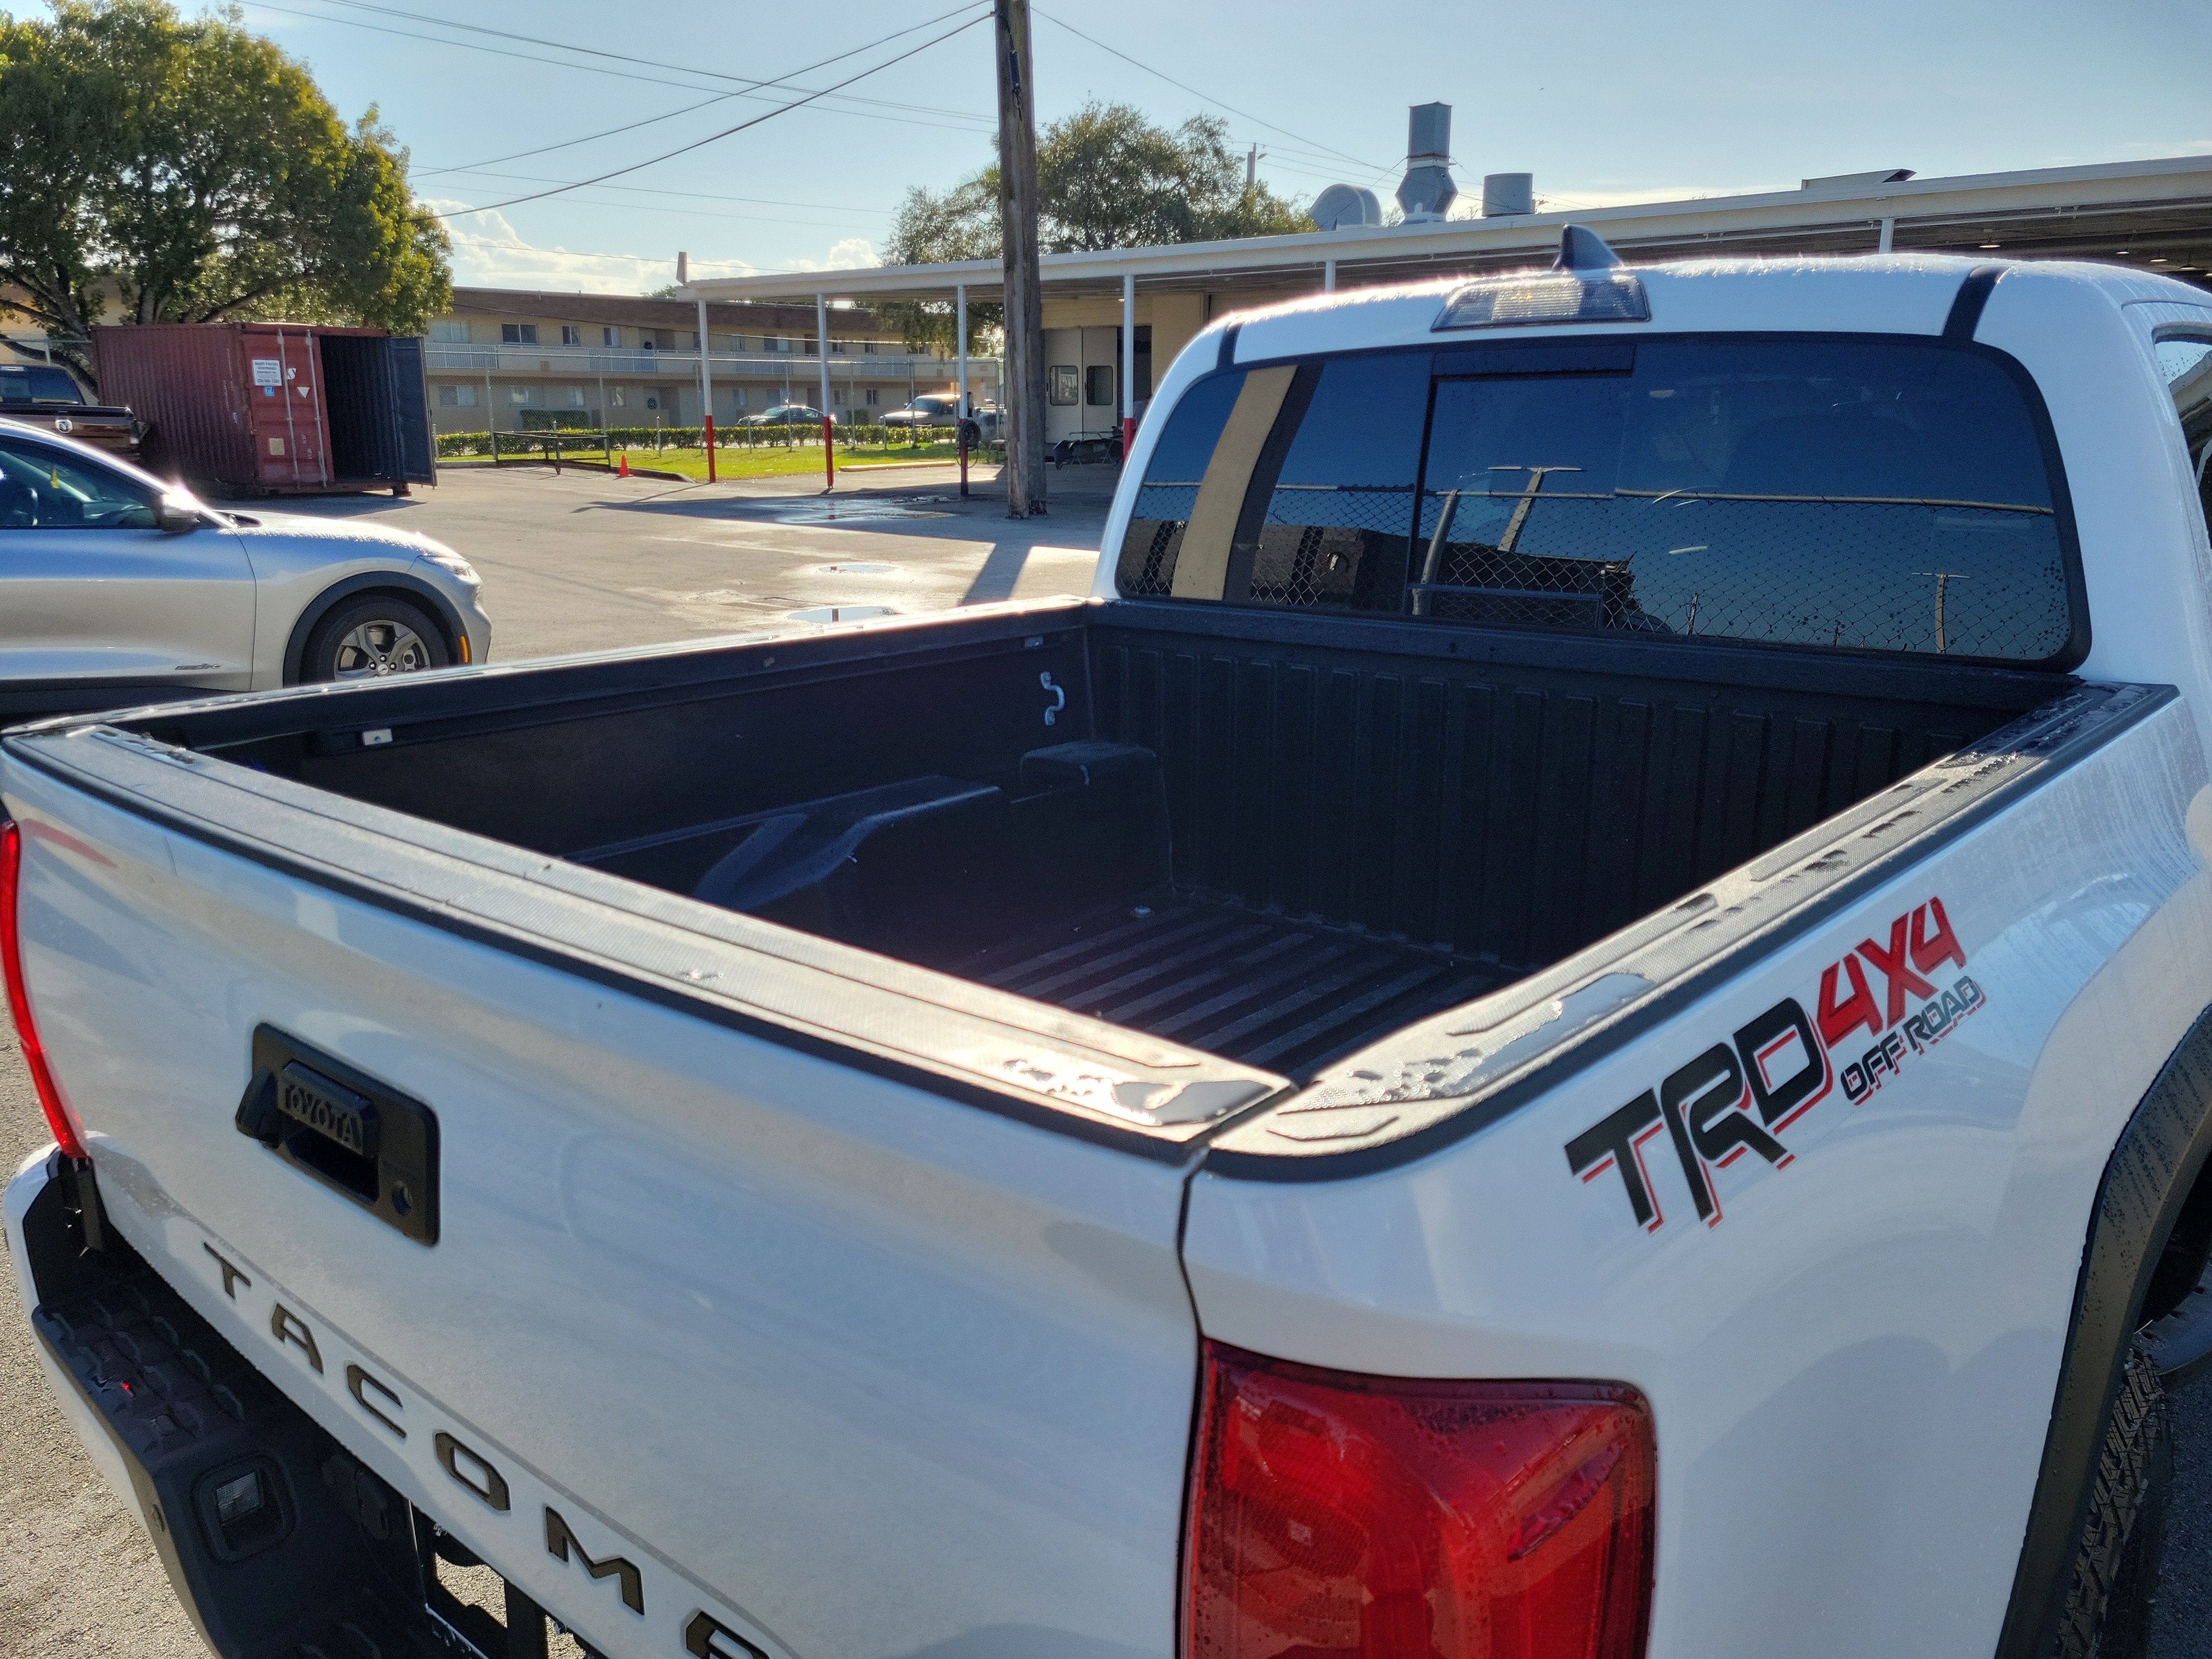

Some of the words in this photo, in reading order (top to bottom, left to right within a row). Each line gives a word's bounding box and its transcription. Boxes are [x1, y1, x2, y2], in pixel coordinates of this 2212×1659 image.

[1565, 997, 1833, 1234] TRD
[1816, 896, 1967, 1051] 4X4
[1841, 1031, 1907, 1106] OFF
[1903, 976, 1987, 1056] ROAD
[281, 1083, 363, 1150] TOYOTA
